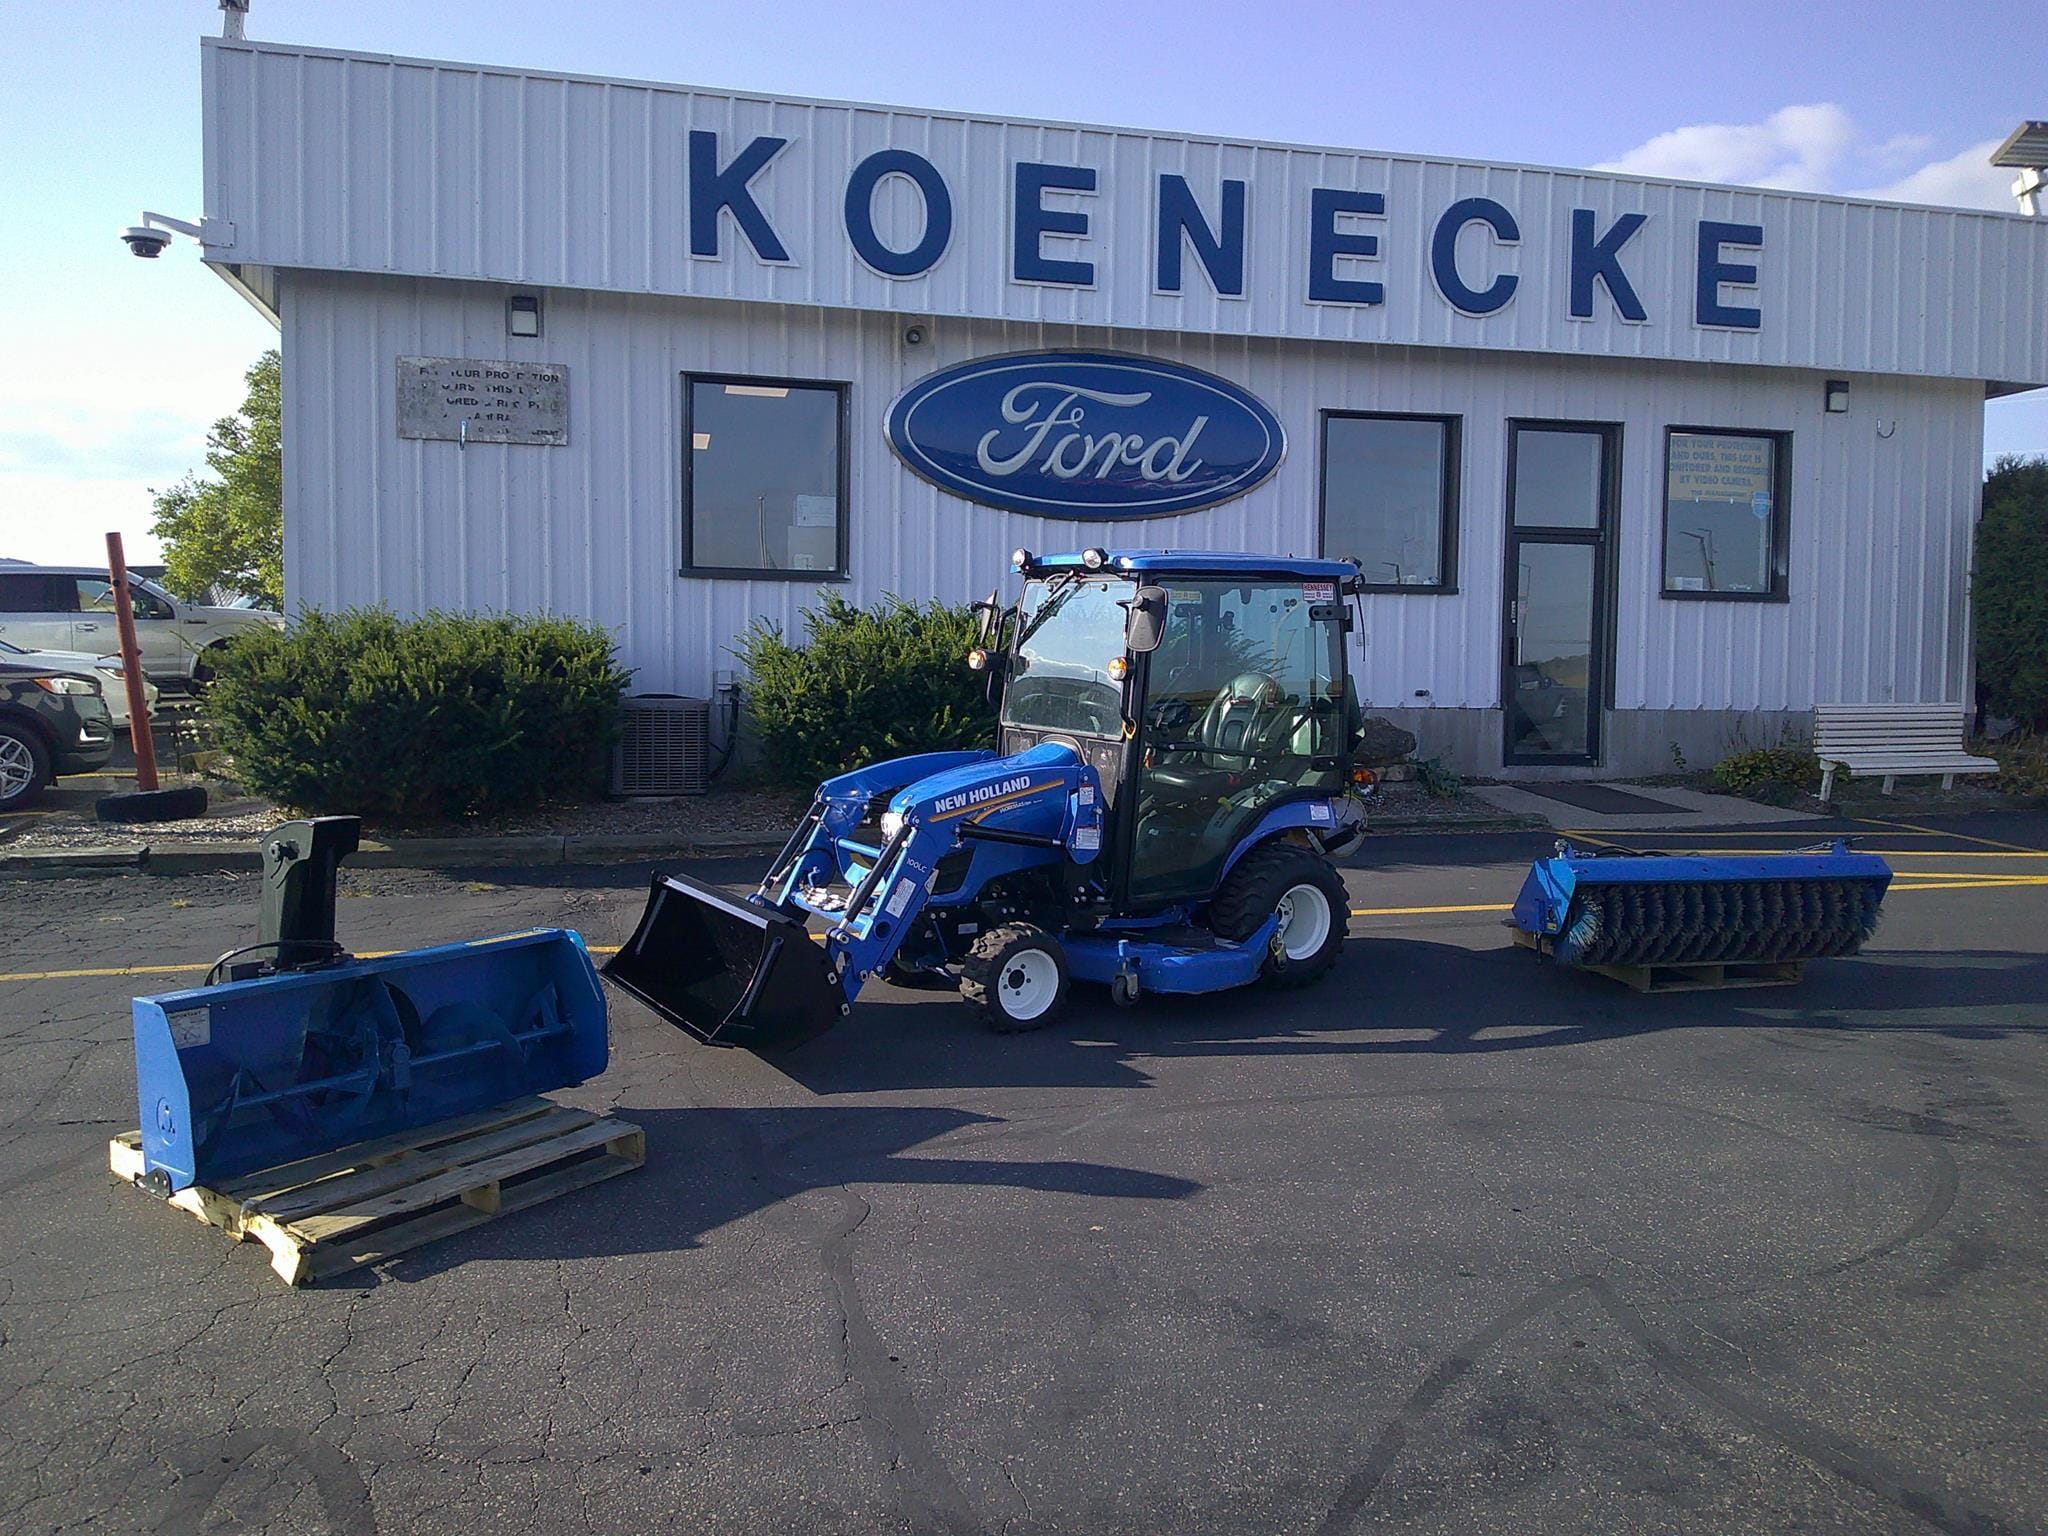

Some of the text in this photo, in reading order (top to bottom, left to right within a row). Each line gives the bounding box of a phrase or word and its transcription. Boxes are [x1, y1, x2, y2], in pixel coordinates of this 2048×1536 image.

[688, 129, 1764, 329] KOENECKE
[976, 381, 1209, 483] Ford
[1691, 439, 1714, 449] YOUR
[1717, 440, 1762, 451] PROTECTION
[1671, 450, 1690, 460] AND
[1720, 452, 1737, 462] THIS
[1739, 453, 1753, 463] LOT
[1713, 463, 1730, 473] AND
[1679, 474, 1690, 484] BY
[1693, 475, 1719, 485] VIDEO
[1303, 584, 1332, 592] HENNESSEY
[934, 775, 1032, 814] NEW HOLLAND
